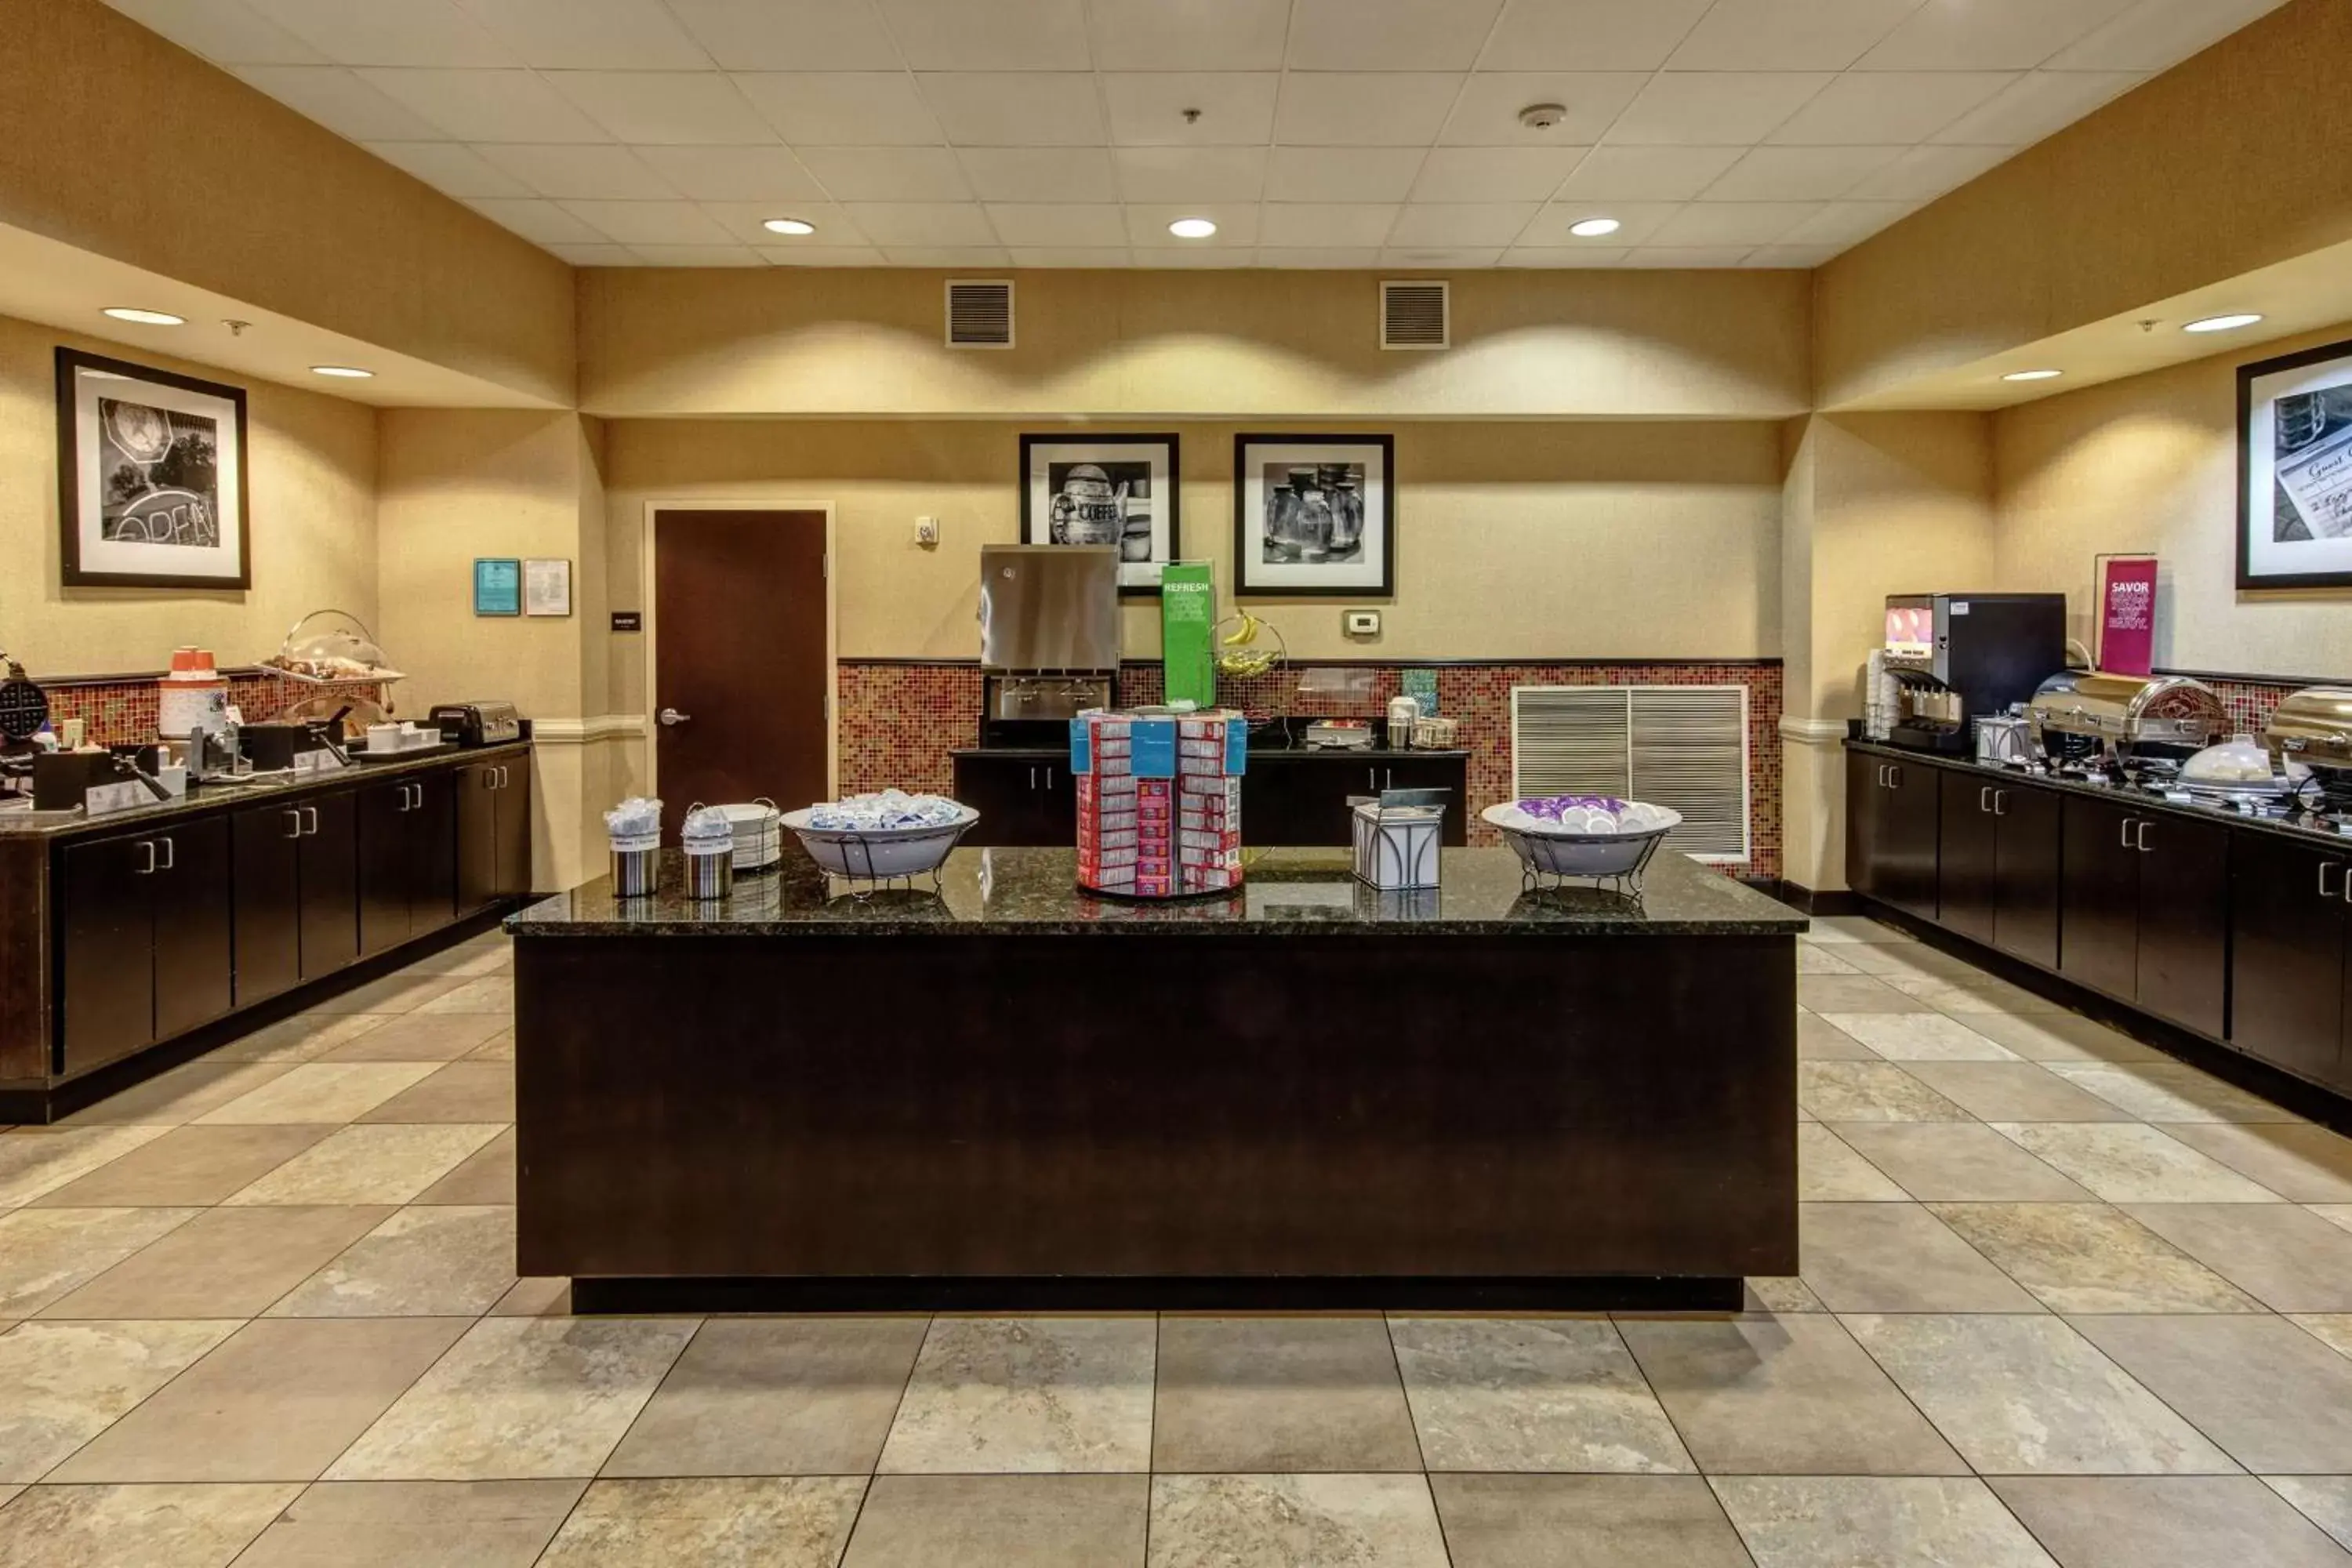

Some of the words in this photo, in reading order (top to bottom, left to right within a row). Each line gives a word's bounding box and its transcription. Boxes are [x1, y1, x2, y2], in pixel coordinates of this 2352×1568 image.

[116, 500, 213, 544] OPEN
[1164, 583, 1208, 593] REFRESH
[2111, 582, 2149, 592] SAVOR
